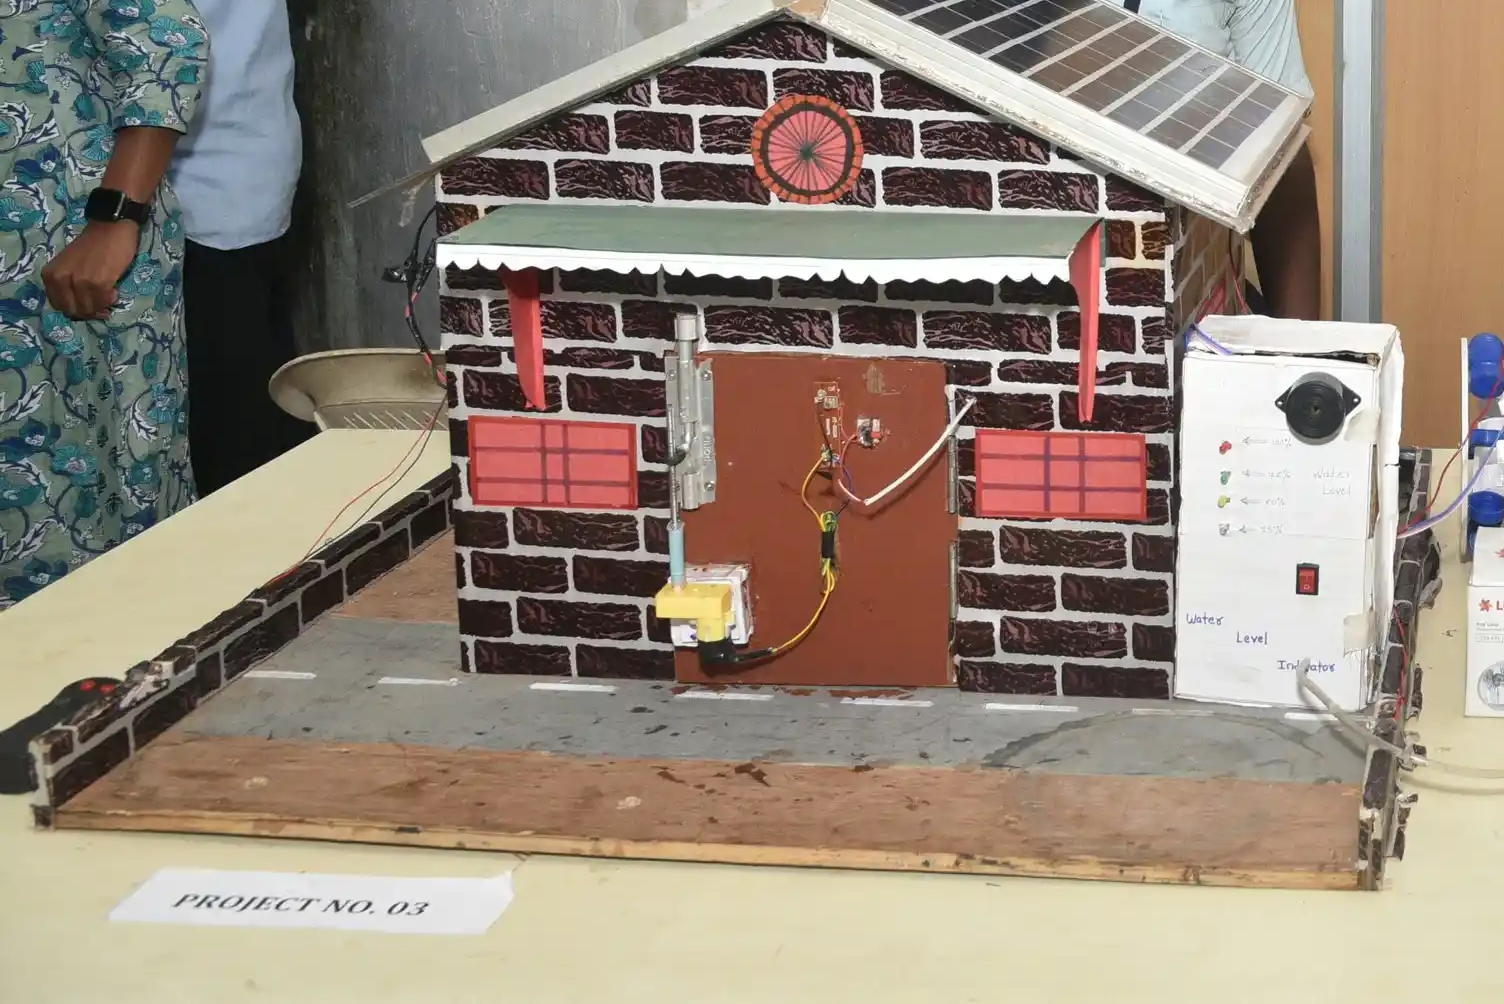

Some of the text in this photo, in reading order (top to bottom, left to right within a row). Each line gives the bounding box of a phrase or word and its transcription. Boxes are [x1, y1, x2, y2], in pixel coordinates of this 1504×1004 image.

[1322, 483, 1351, 496] Level
[1186, 612, 1224, 626] Water
[1236, 630, 1268, 645] Level
[171, 893, 431, 917] PROJECT NO. 03
